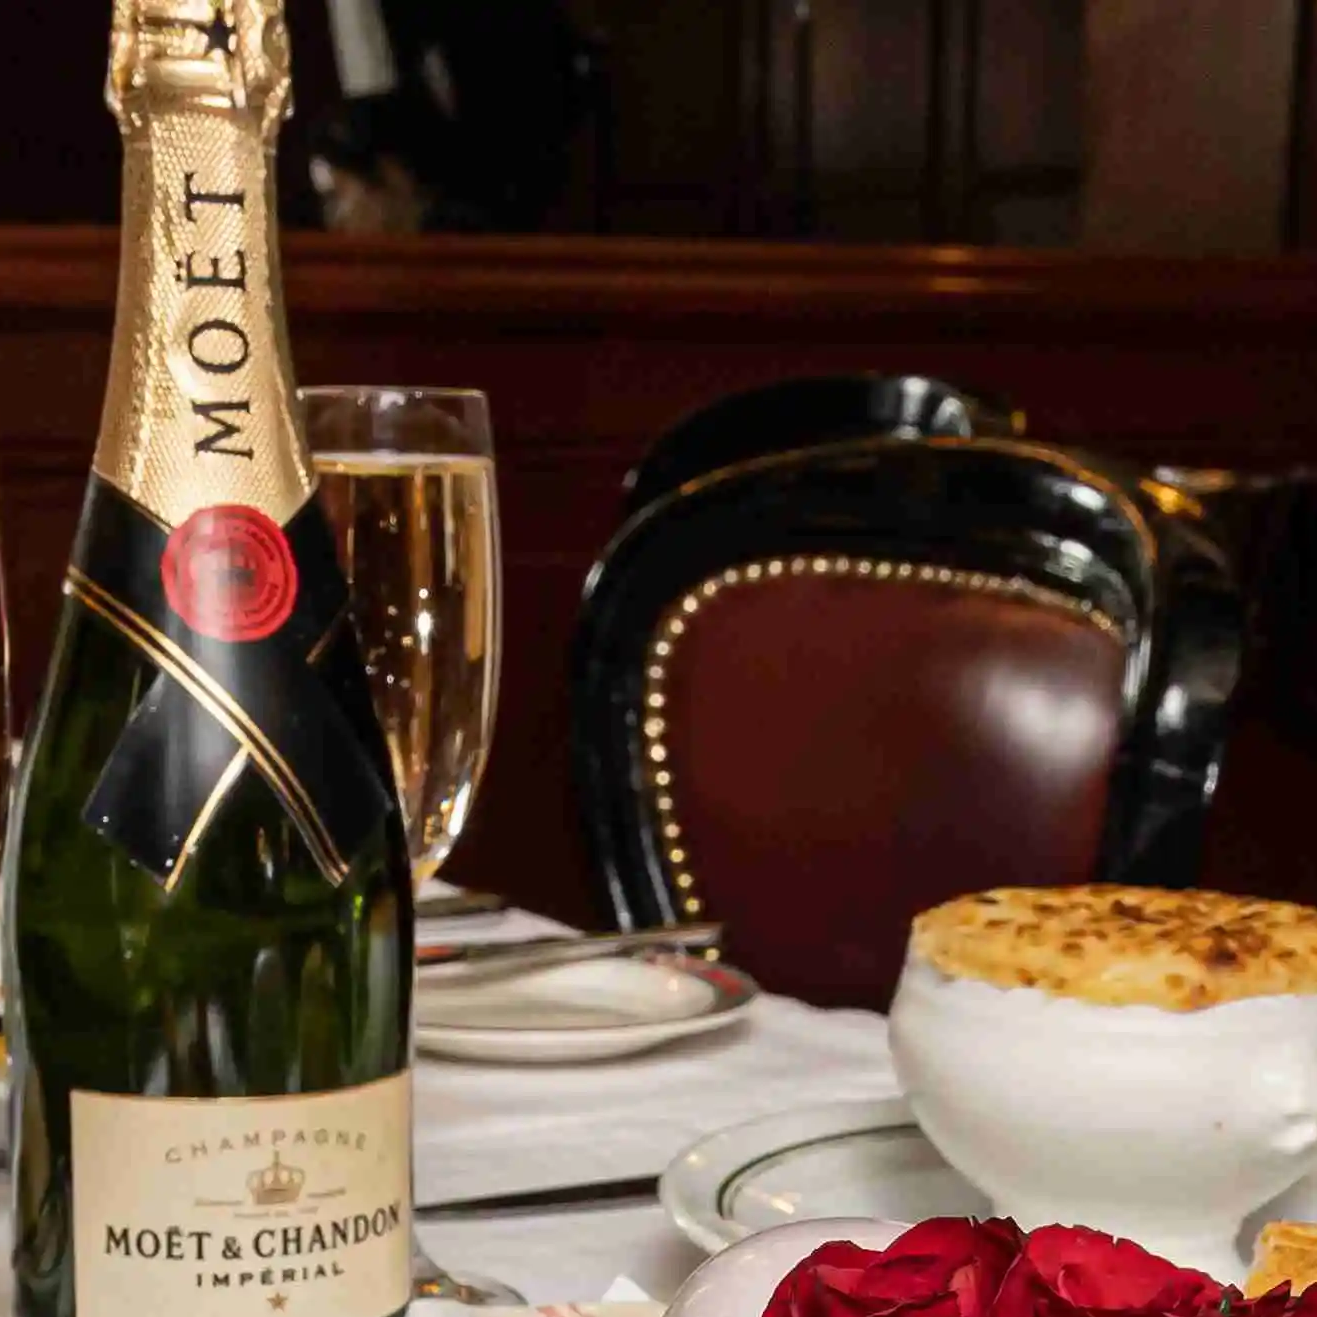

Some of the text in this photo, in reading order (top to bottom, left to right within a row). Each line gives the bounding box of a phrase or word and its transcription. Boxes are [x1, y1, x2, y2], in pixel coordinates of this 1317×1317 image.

[175, 172, 254, 460] MOËT
[165, 1128, 367, 1163] CHAMPAGNE
[105, 1202, 402, 1260] MOËT & CHANDON
[196, 1260, 345, 1287] IMPÉRIAL
